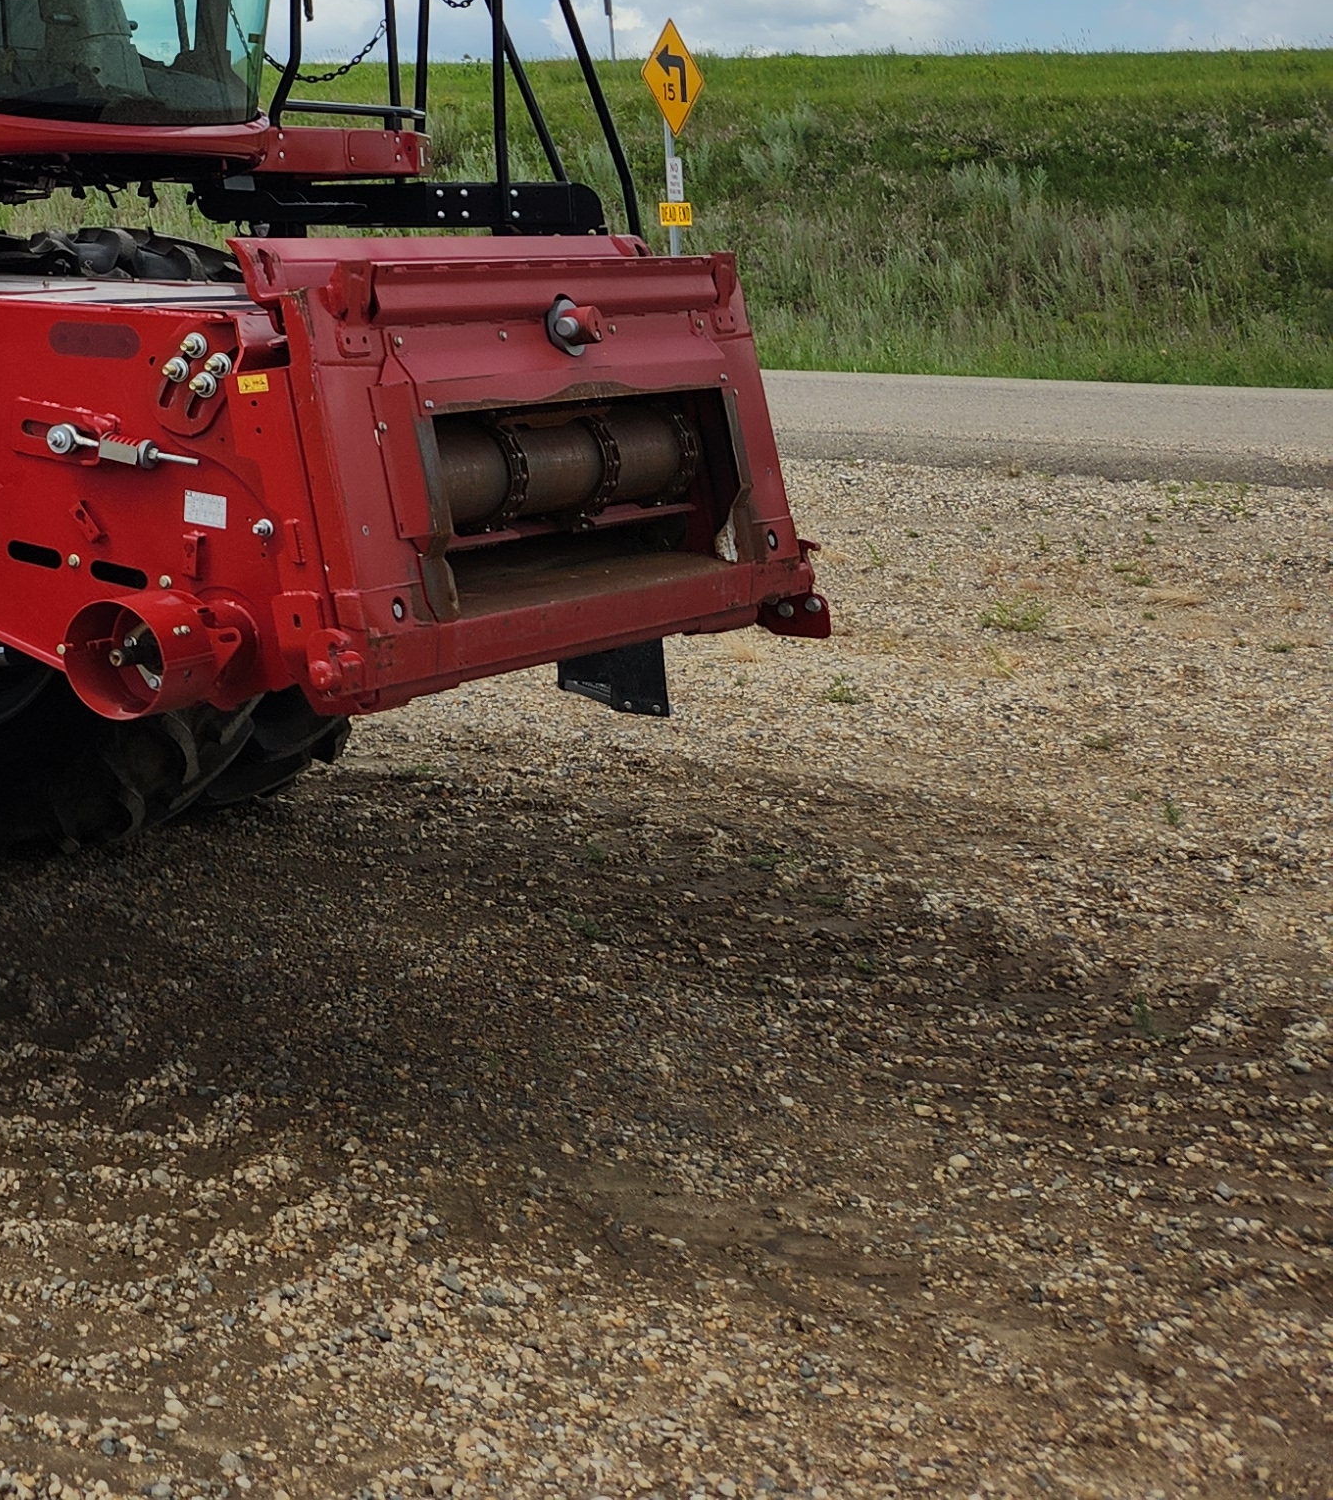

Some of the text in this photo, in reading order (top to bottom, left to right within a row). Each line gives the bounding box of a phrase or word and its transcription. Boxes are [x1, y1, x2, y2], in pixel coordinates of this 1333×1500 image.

[663, 82, 676, 102] 15
[661, 205, 691, 223] DEAD END
